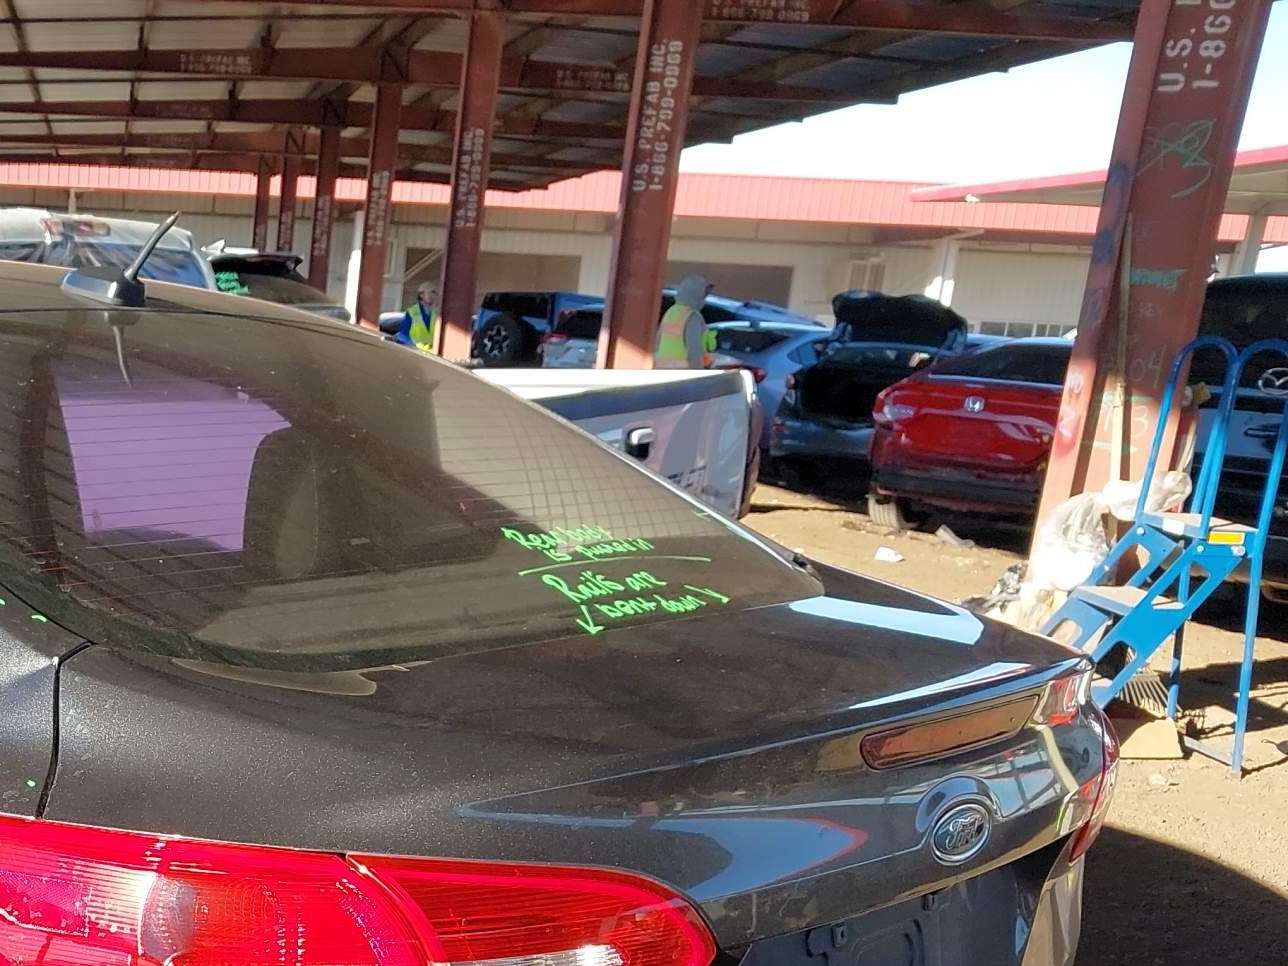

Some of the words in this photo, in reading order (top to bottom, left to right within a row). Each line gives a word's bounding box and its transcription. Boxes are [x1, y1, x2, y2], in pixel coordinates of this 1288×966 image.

[650, 39, 668, 73] INC.
[1157, 27, 1196, 92] U.S.
[638, 81, 661, 149] PREFAB
[632, 159, 650, 192] U.S.
